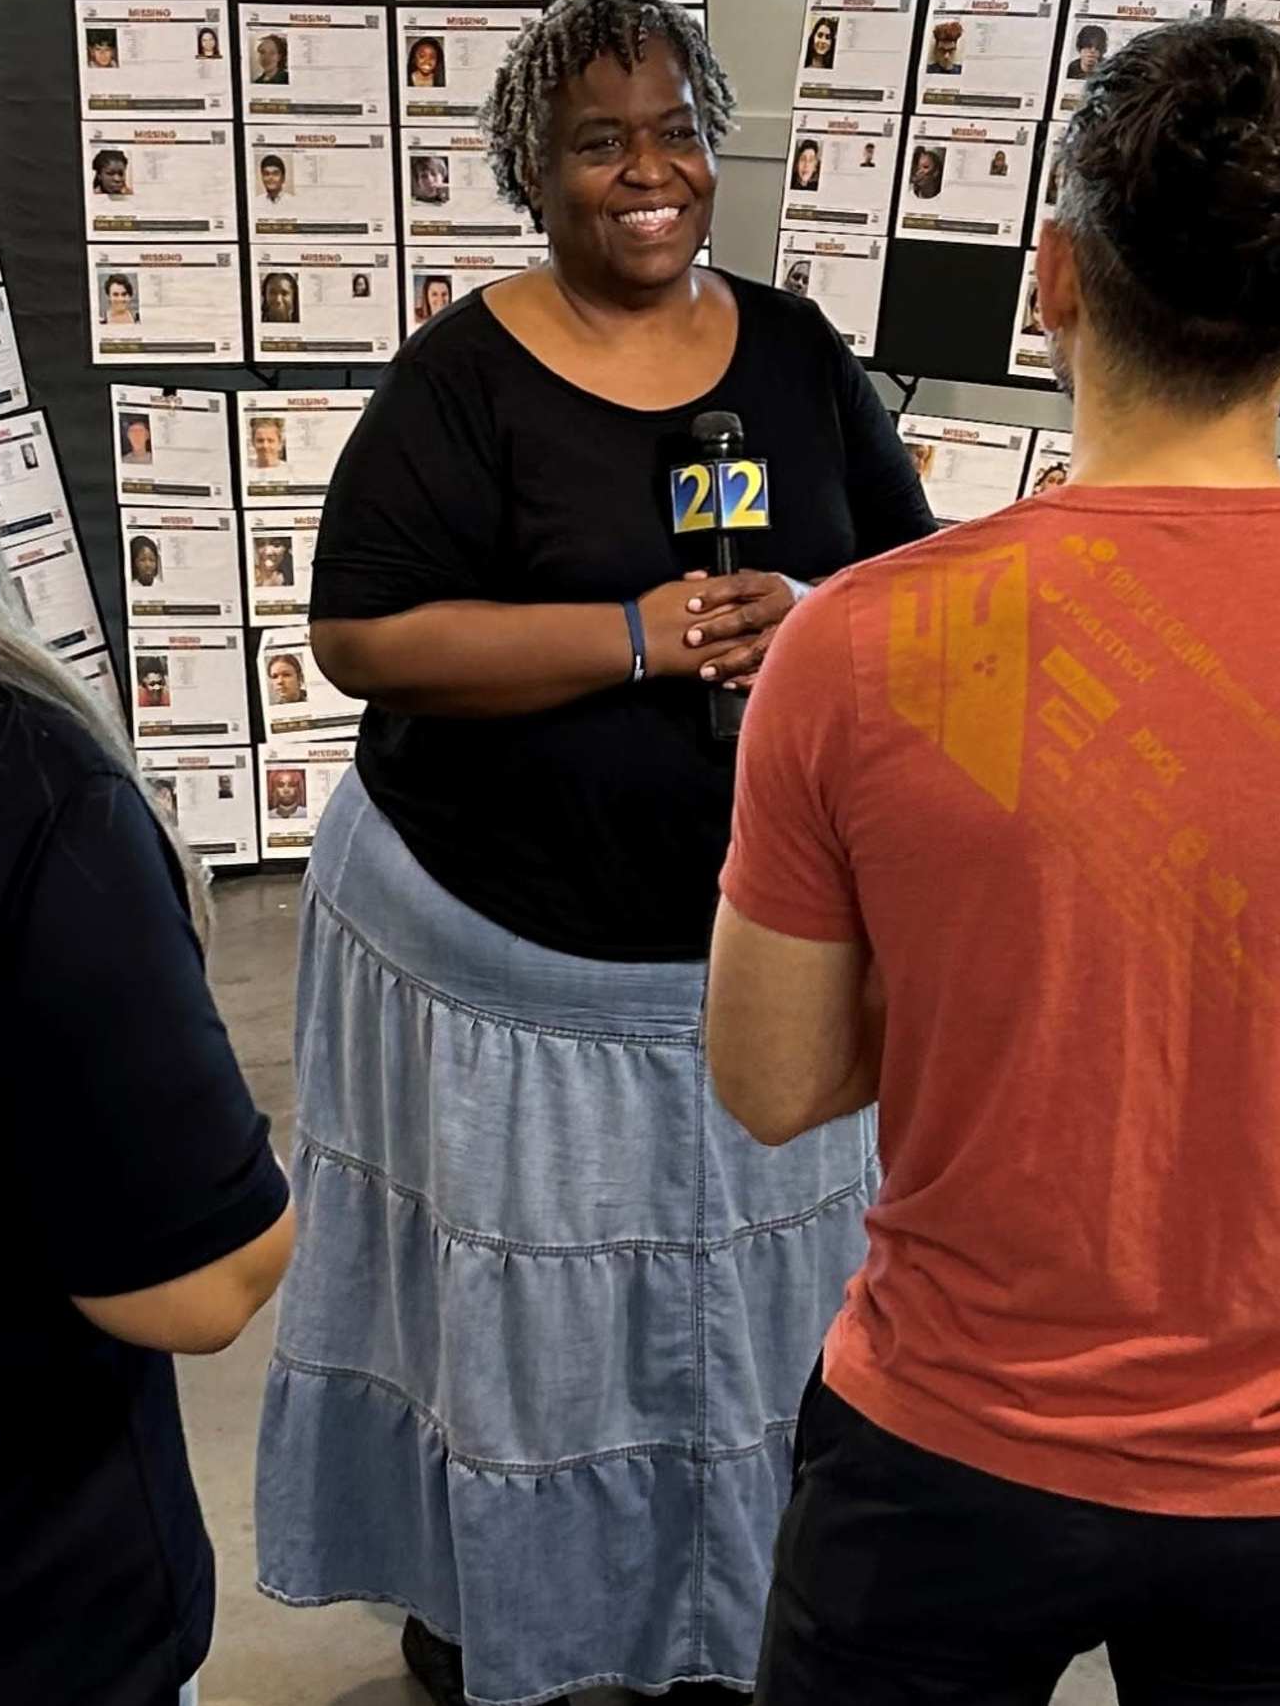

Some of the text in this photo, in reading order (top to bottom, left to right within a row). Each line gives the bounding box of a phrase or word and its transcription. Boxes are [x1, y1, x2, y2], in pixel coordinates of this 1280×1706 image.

[128, 9, 171, 18] MISSING
[289, 13, 331, 23] MISSING
[446, 17, 488, 26] MISSING
[134, 130, 176, 139] MISSING
[295, 134, 336, 143] MISSING
[451, 136, 485, 146] MISSIN
[139, 253, 183, 263] MISSING
[300, 253, 342, 263] MISSING
[454, 255, 495, 265] MISSING
[287, 397, 329, 407] MISSING
[308, 748, 350, 760] MISSING
